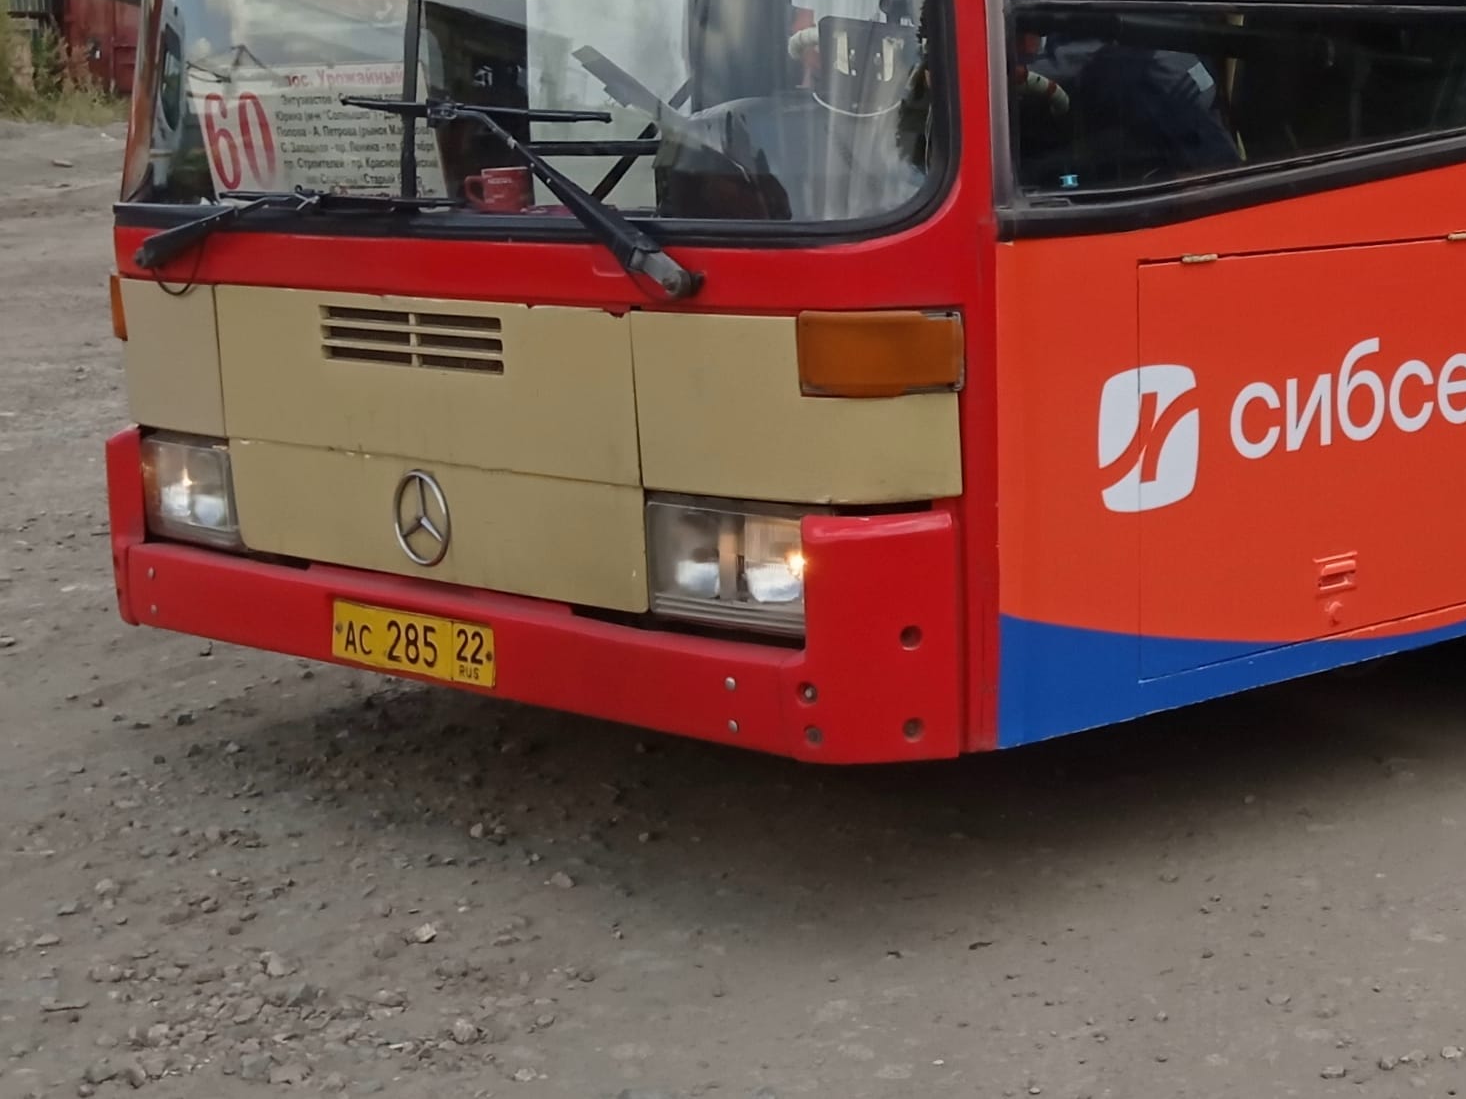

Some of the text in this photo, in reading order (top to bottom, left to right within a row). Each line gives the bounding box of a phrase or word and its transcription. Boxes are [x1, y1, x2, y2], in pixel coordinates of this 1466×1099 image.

[203, 91, 277, 191] 60
[386, 620, 439, 669] 285
[455, 628, 485, 666] 22
[458, 664, 481, 680] RUS
